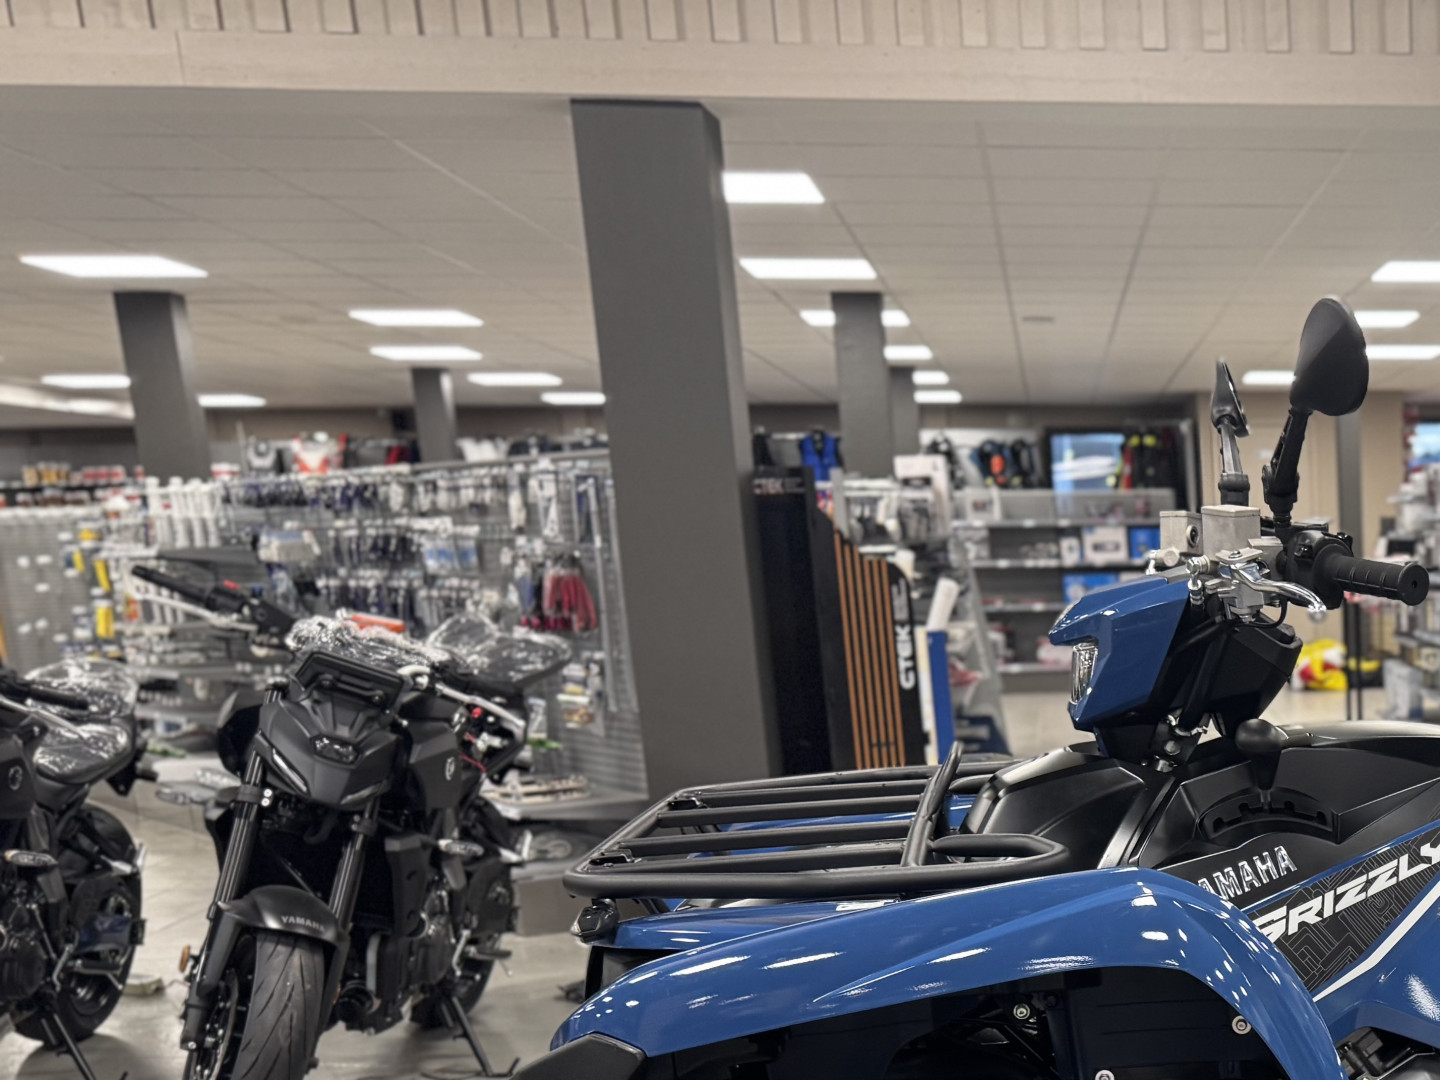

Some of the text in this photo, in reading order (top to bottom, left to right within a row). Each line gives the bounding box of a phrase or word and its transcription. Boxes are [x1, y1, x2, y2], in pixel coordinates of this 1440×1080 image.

[894, 624, 917, 690] CTEK
[1198, 845, 1298, 901] AMAHA
[281, 915, 325, 932] YAMAHA
